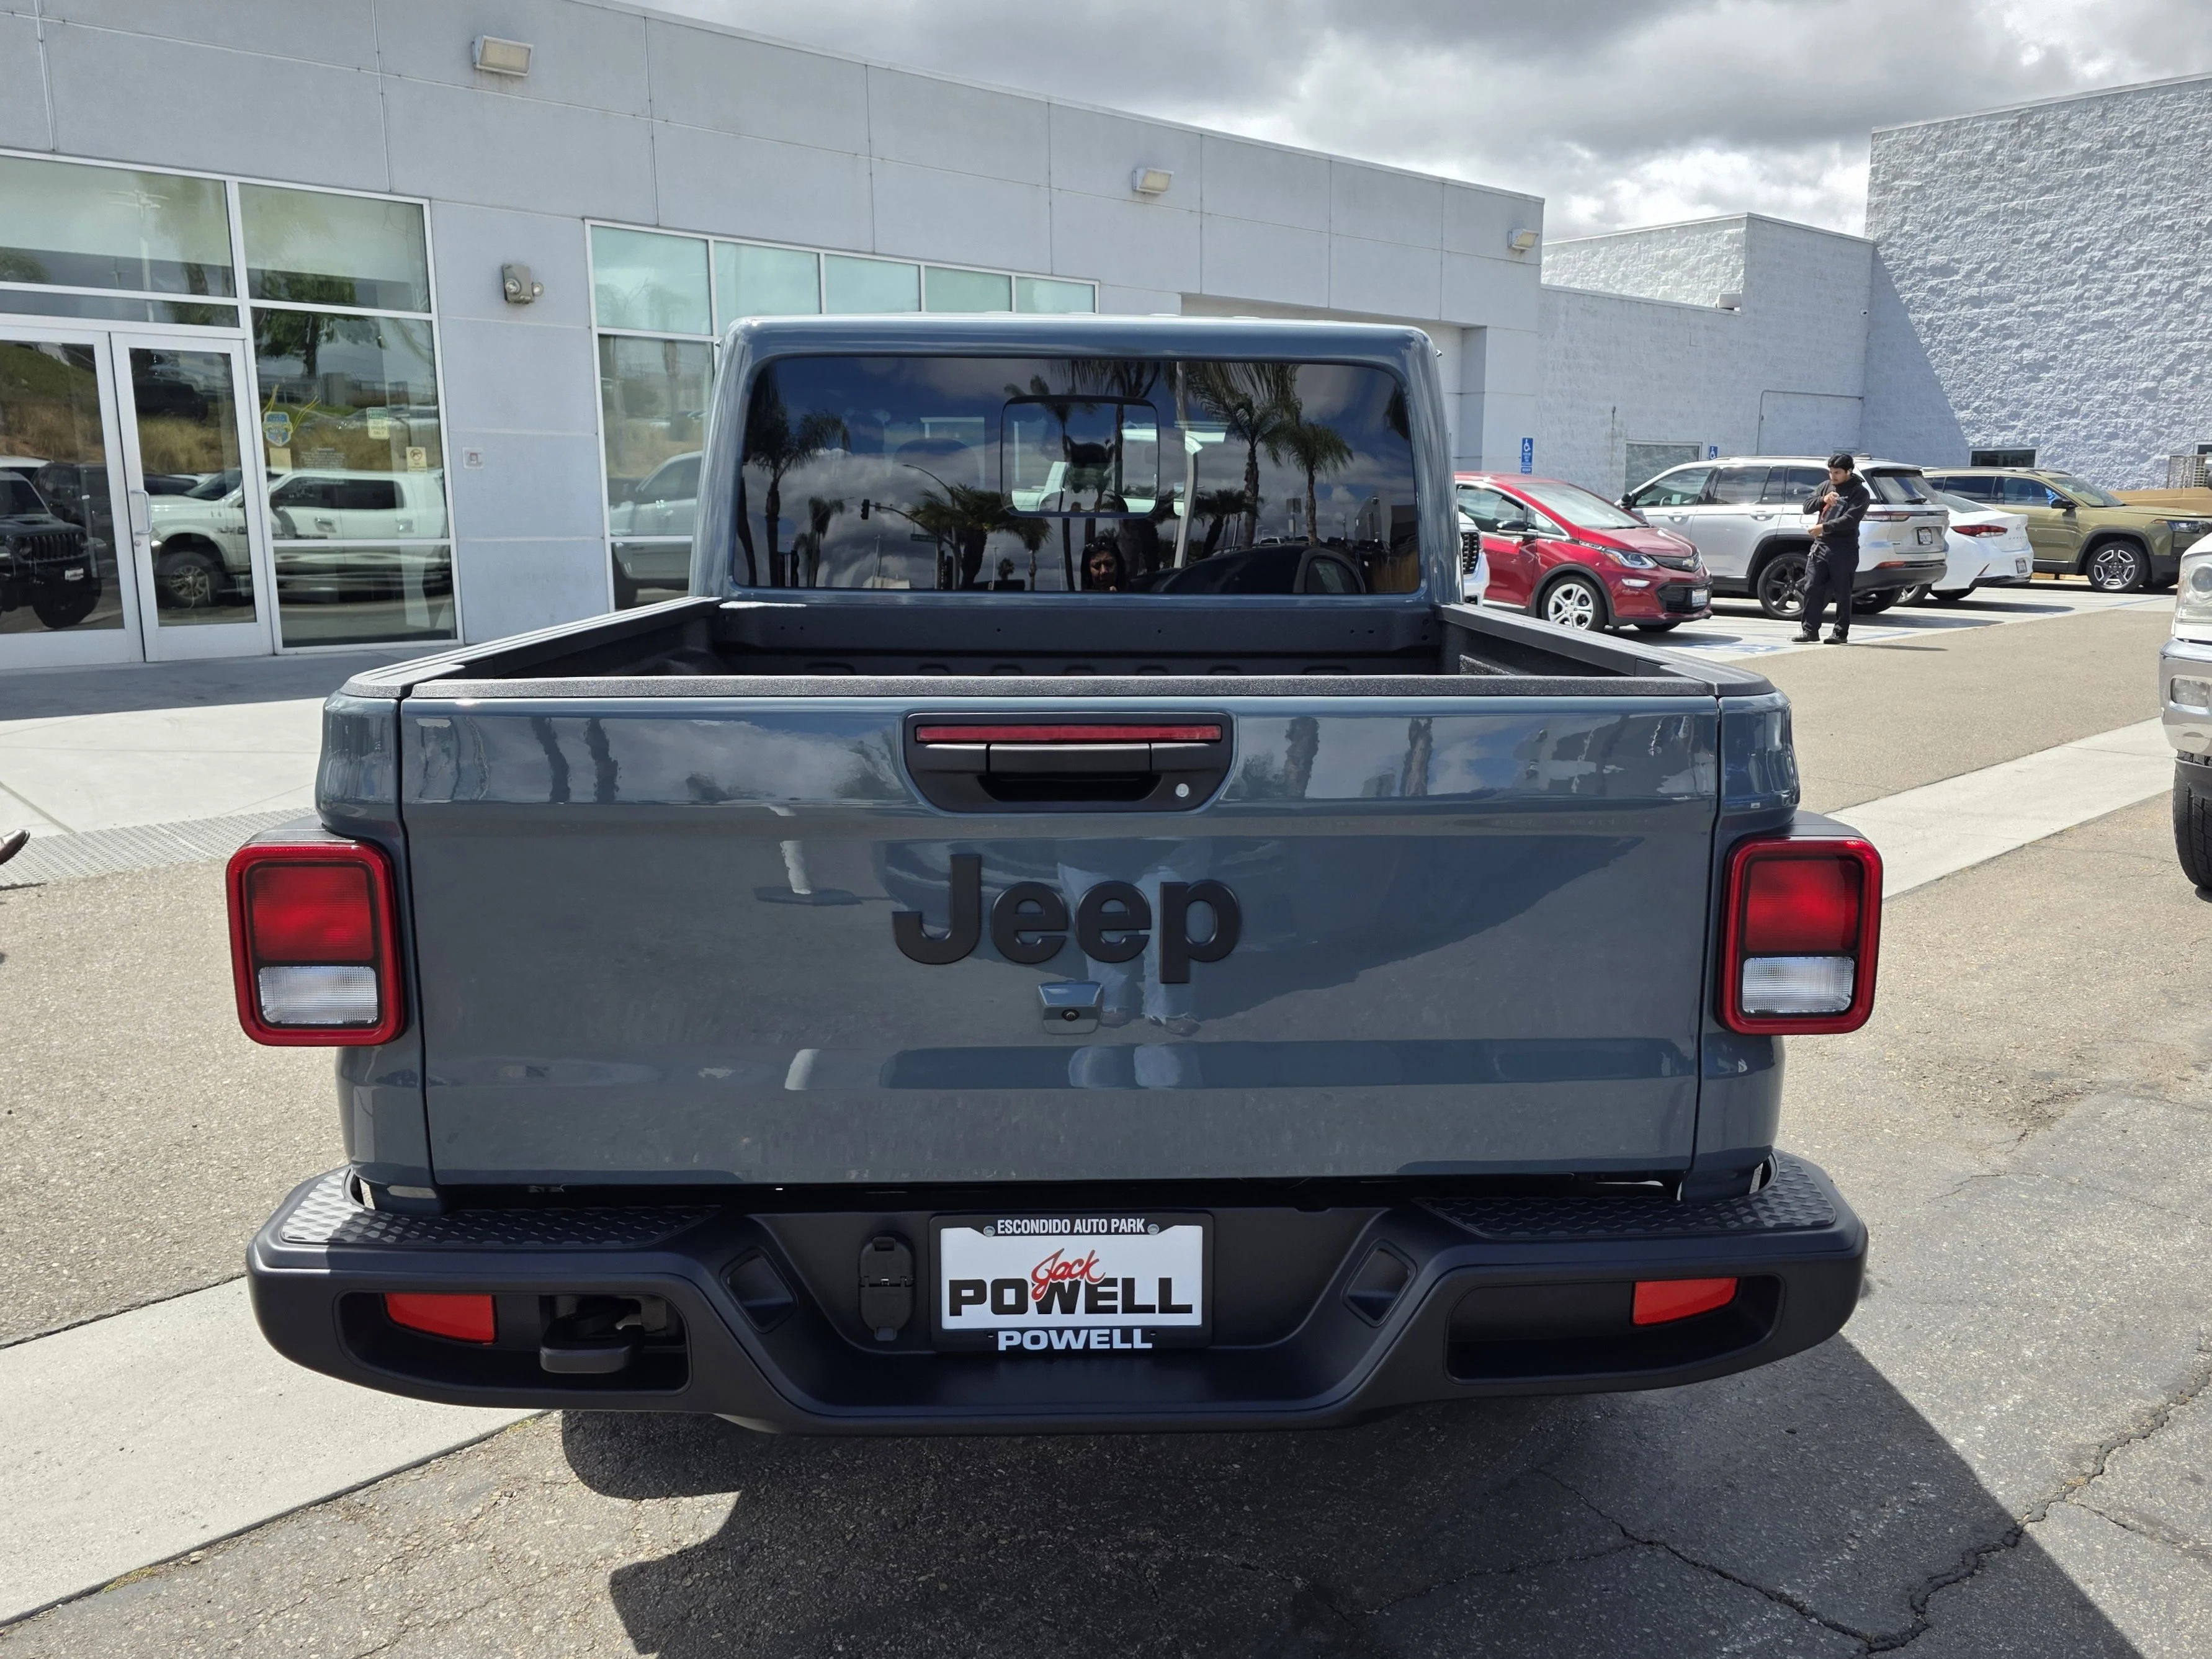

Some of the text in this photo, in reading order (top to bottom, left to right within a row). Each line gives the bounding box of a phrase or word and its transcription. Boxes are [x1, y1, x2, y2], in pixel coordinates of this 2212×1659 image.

[892, 854, 1240, 983] Jeep
[997, 1219, 1145, 1234] ESCONDIDO AUTO PARK
[1031, 1248, 1106, 1302] Jack
[949, 1277, 1193, 1316] POWELL
[998, 1329, 1152, 1351] POWELL
